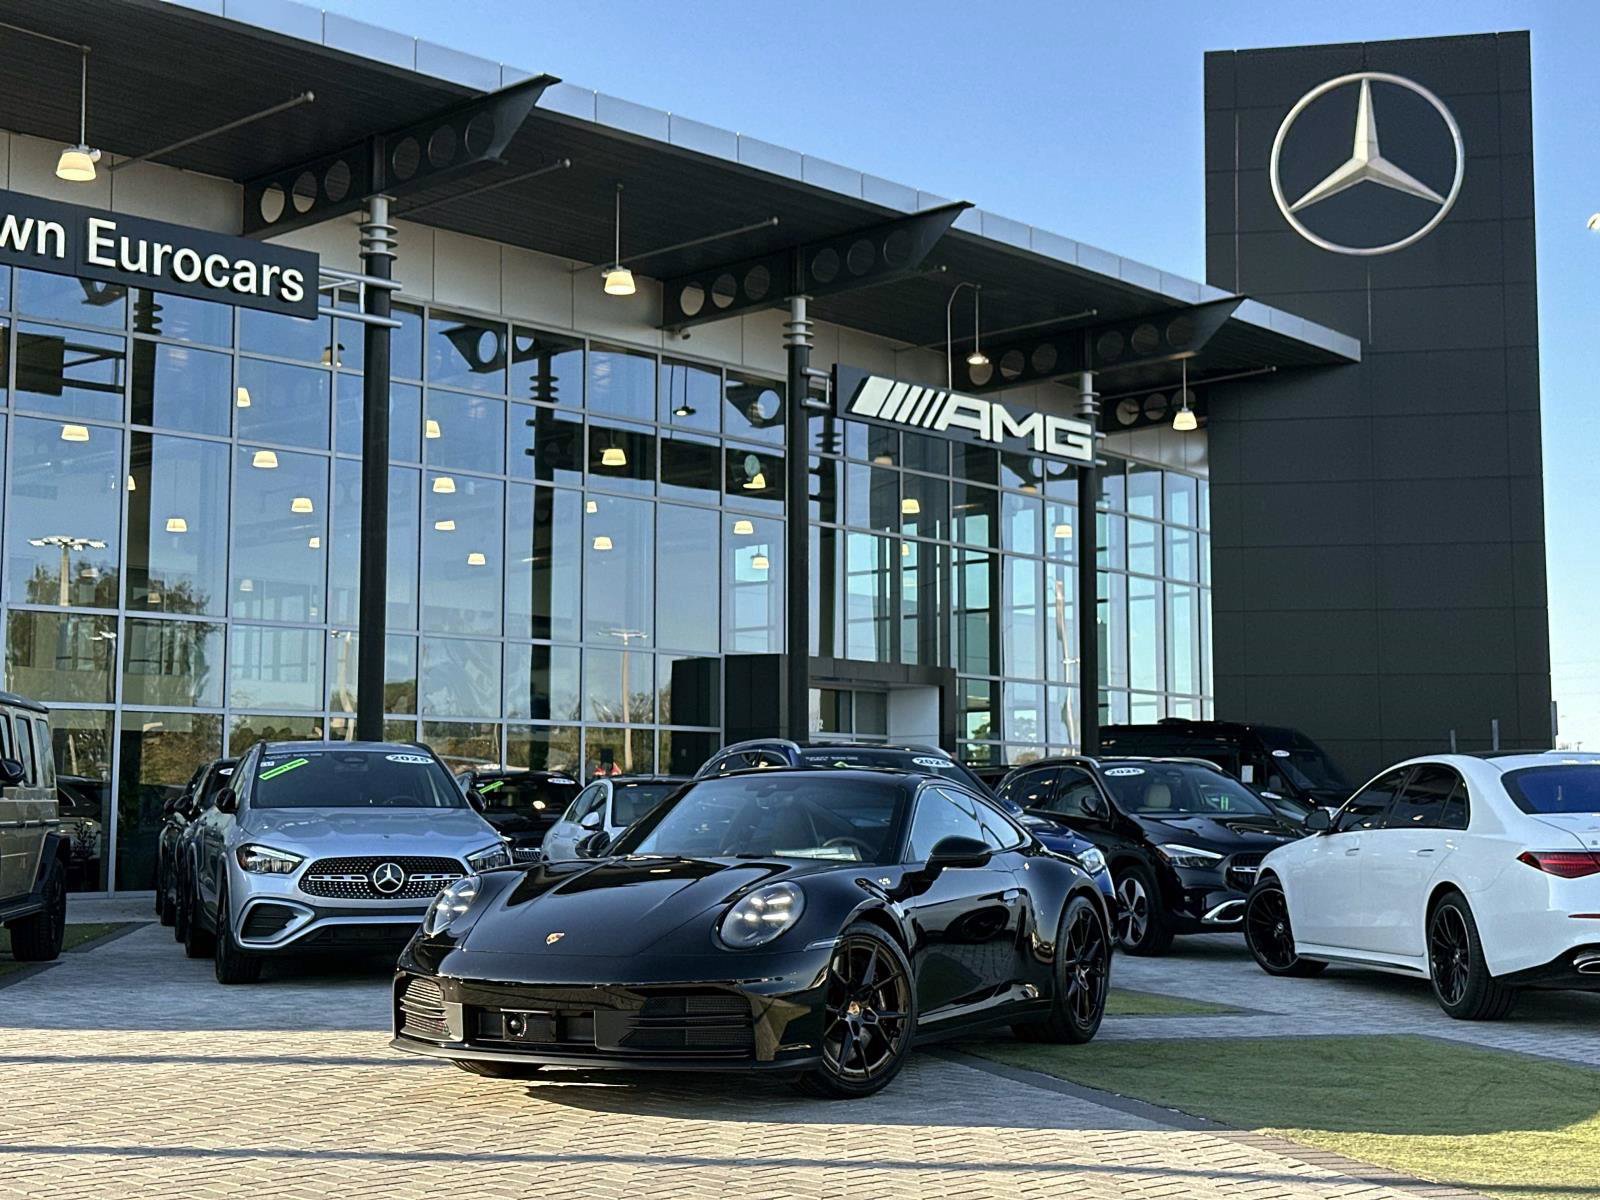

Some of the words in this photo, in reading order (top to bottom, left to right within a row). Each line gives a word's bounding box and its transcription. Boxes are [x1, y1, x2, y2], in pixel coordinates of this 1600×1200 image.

[87, 217, 304, 302] Eurocars
[934, 393, 1092, 461] AMG
[390, 755, 430, 763] 2025
